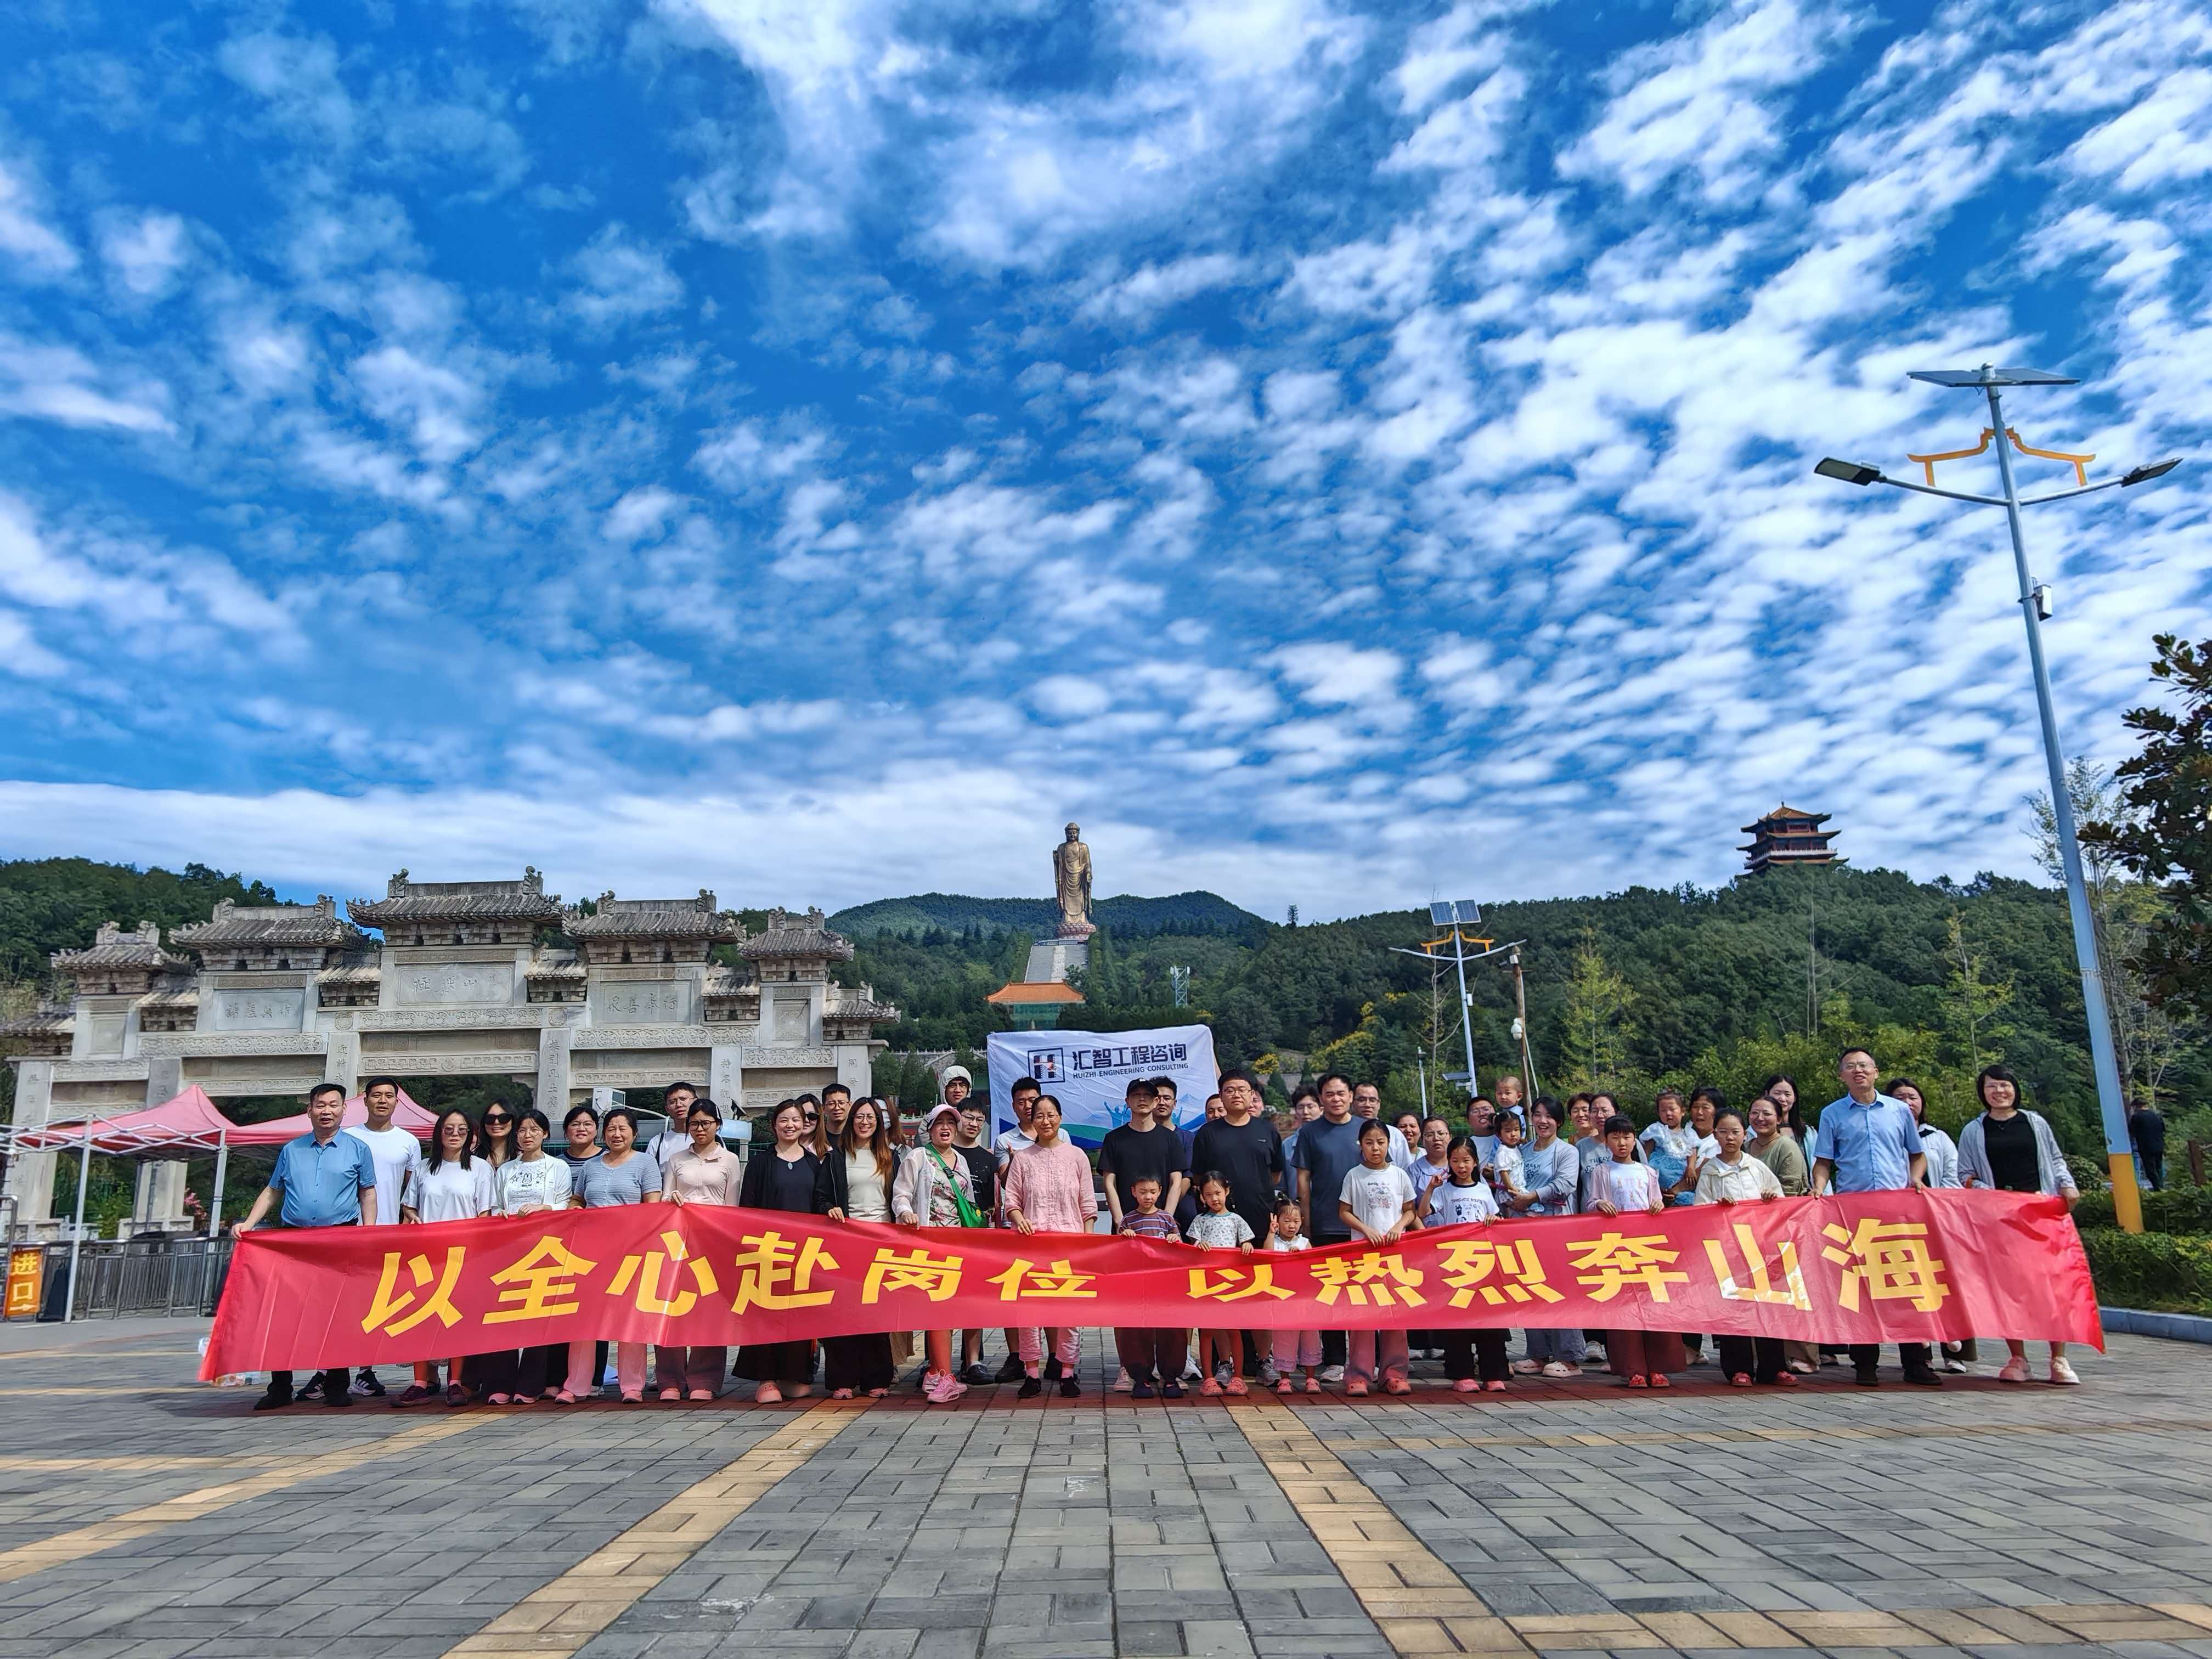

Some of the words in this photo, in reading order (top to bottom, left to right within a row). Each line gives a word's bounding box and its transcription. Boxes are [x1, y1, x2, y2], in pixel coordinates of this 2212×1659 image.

[1073, 1042, 1187, 1071] 汇智工程咨询
[1099, 1066, 1145, 1077] ENGINEERING
[1147, 1063, 1189, 1071] CONSULTING
[10, 1252, 38, 1301] 进口
[361, 1232, 1097, 1337] 以全心赴岗位
[1187, 1218, 1950, 1313] 以热烈奔山海
